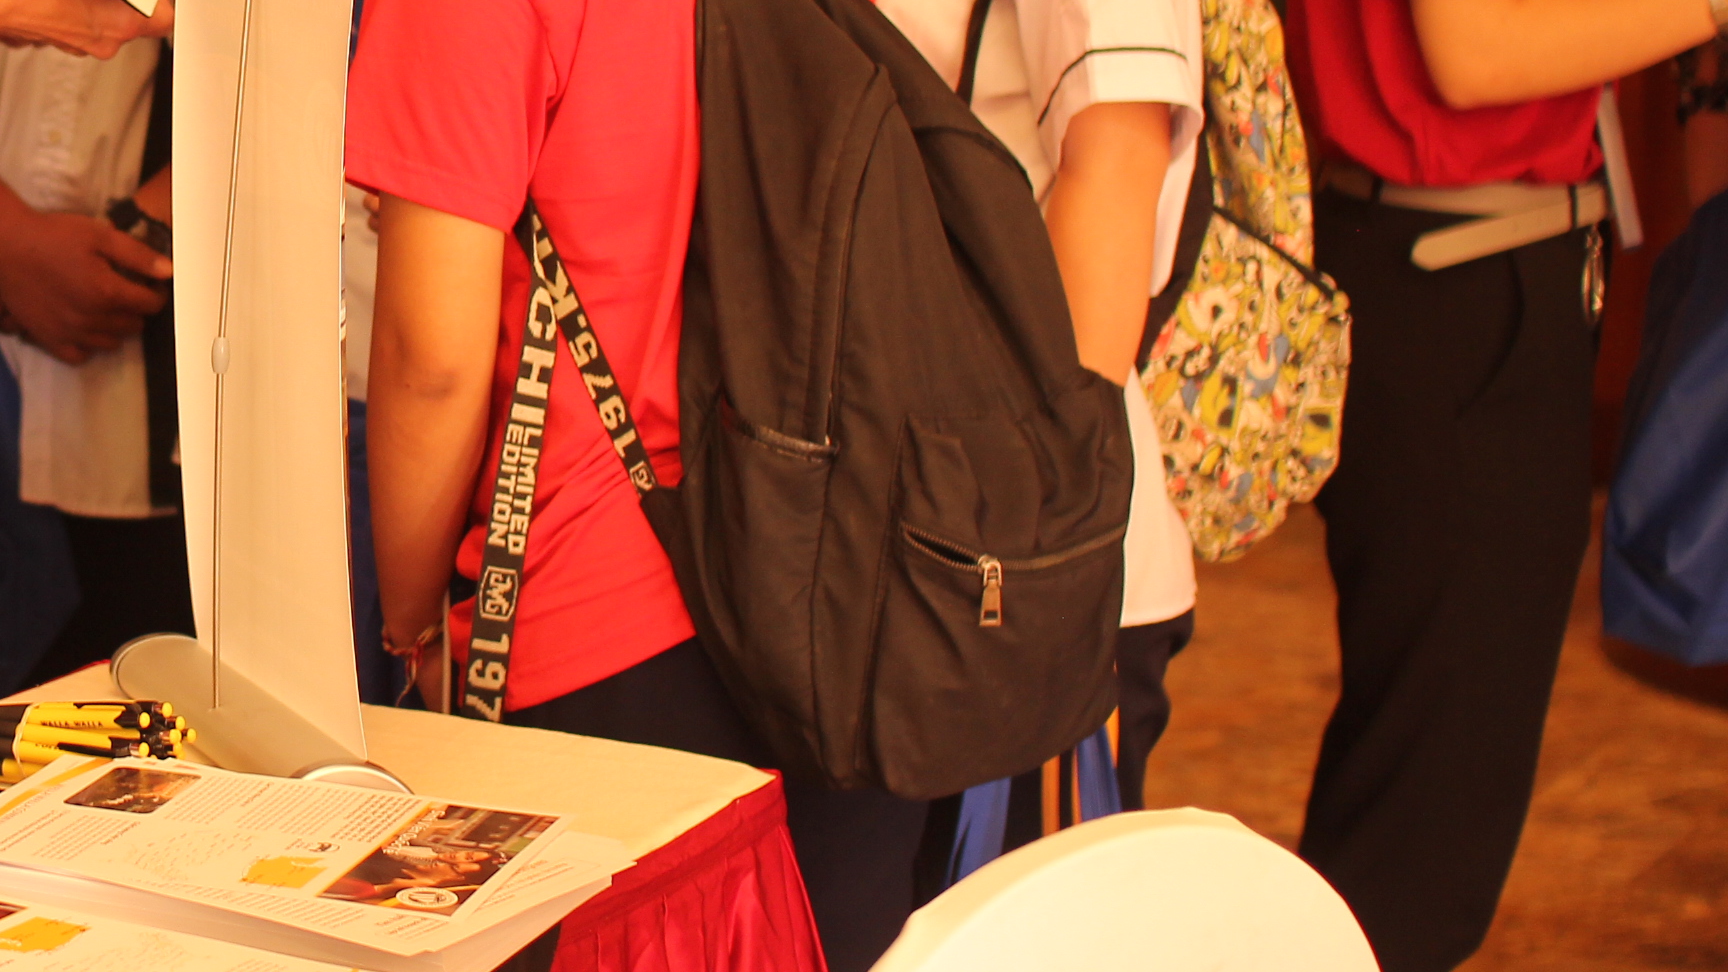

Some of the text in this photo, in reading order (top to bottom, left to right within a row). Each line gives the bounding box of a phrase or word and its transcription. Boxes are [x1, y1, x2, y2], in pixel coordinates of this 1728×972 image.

[486, 422, 524, 548] EDITION
[507, 427, 543, 556] LIMITED
[40, 720, 104, 729] WALLA WALLA
